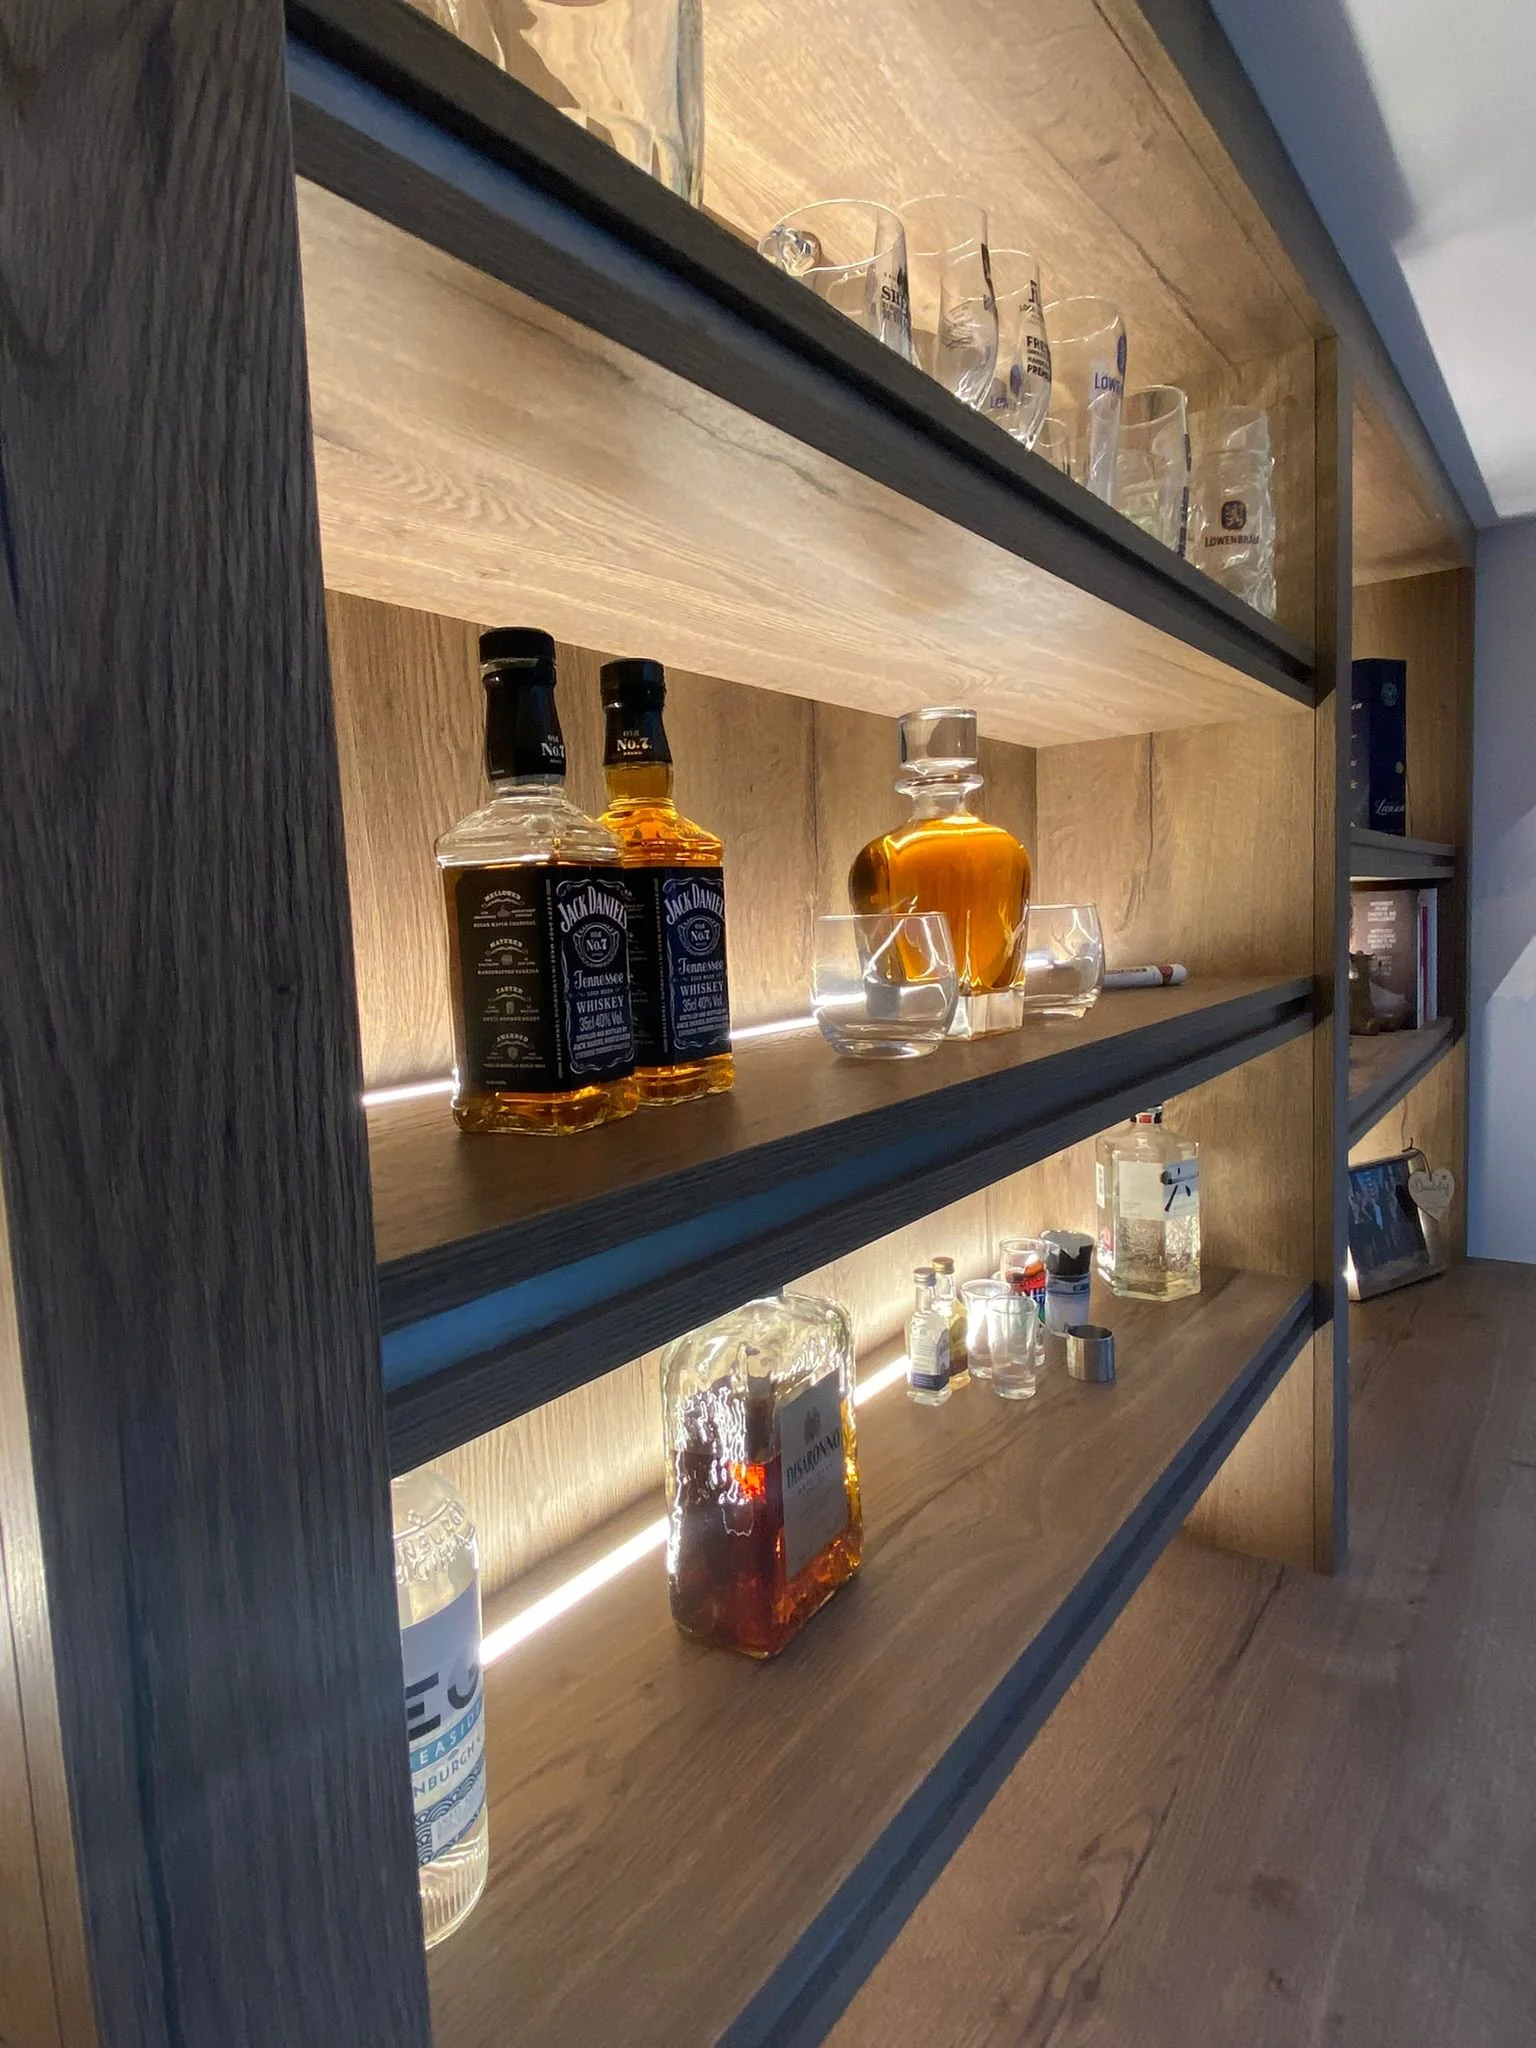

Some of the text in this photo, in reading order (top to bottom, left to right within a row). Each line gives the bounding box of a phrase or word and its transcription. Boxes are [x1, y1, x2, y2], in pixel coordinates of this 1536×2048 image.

[557, 893, 590, 934] JACK
[663, 882, 725, 926] JACK DANIEL
[495, 985, 524, 995] TASTED
[573, 969, 625, 990] Tennessee
[679, 980, 724, 997] WHISKEY
[576, 994, 625, 1015] WHISKEY
